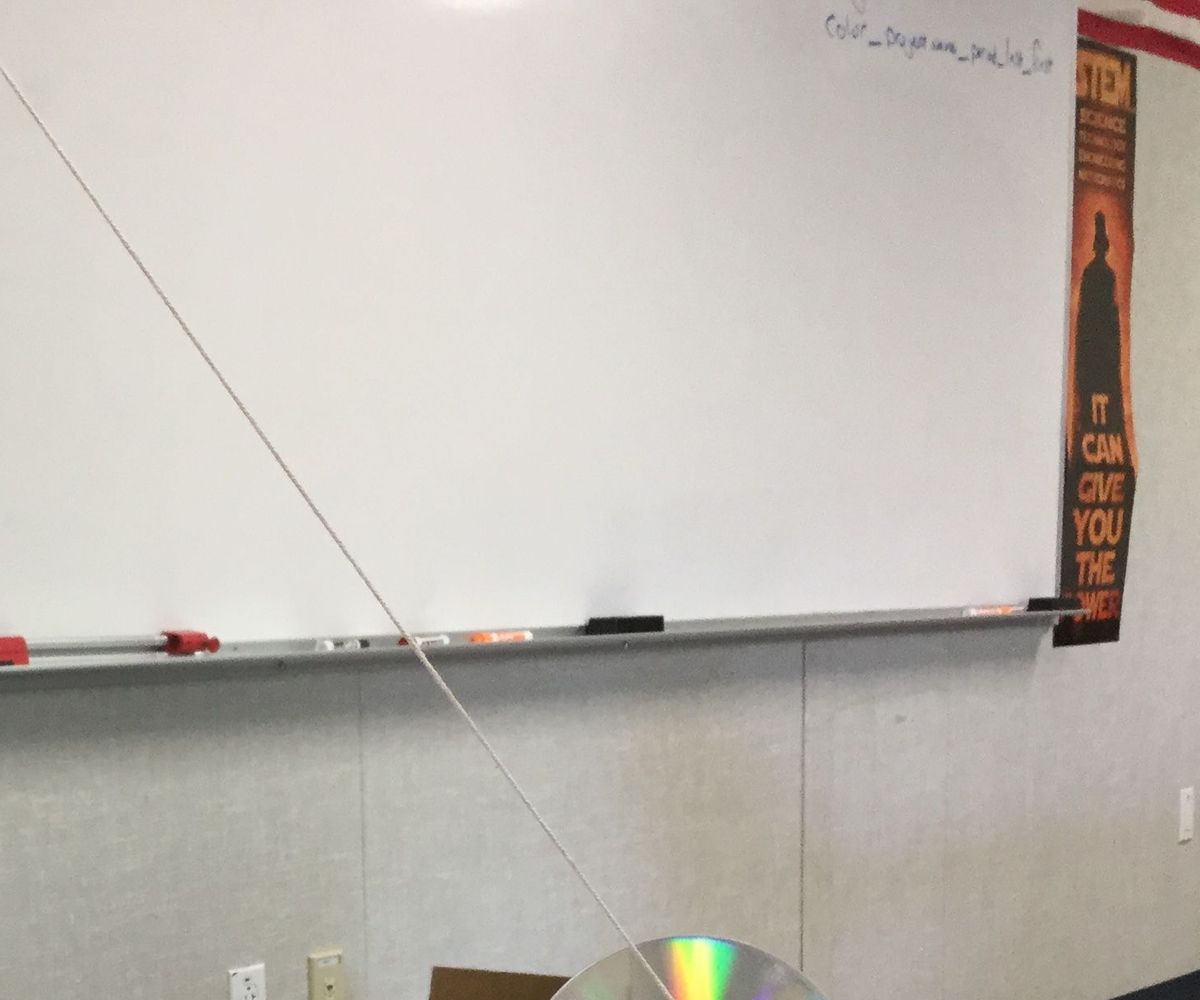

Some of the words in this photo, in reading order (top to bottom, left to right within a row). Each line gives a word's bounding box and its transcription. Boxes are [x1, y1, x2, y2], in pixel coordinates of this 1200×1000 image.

[1081, 433, 1124, 465] CAN
[1077, 471, 1125, 503] GIVE
[1071, 507, 1125, 546] YOU
[1075, 550, 1117, 585] THE
[1059, 591, 1121, 624] WER
